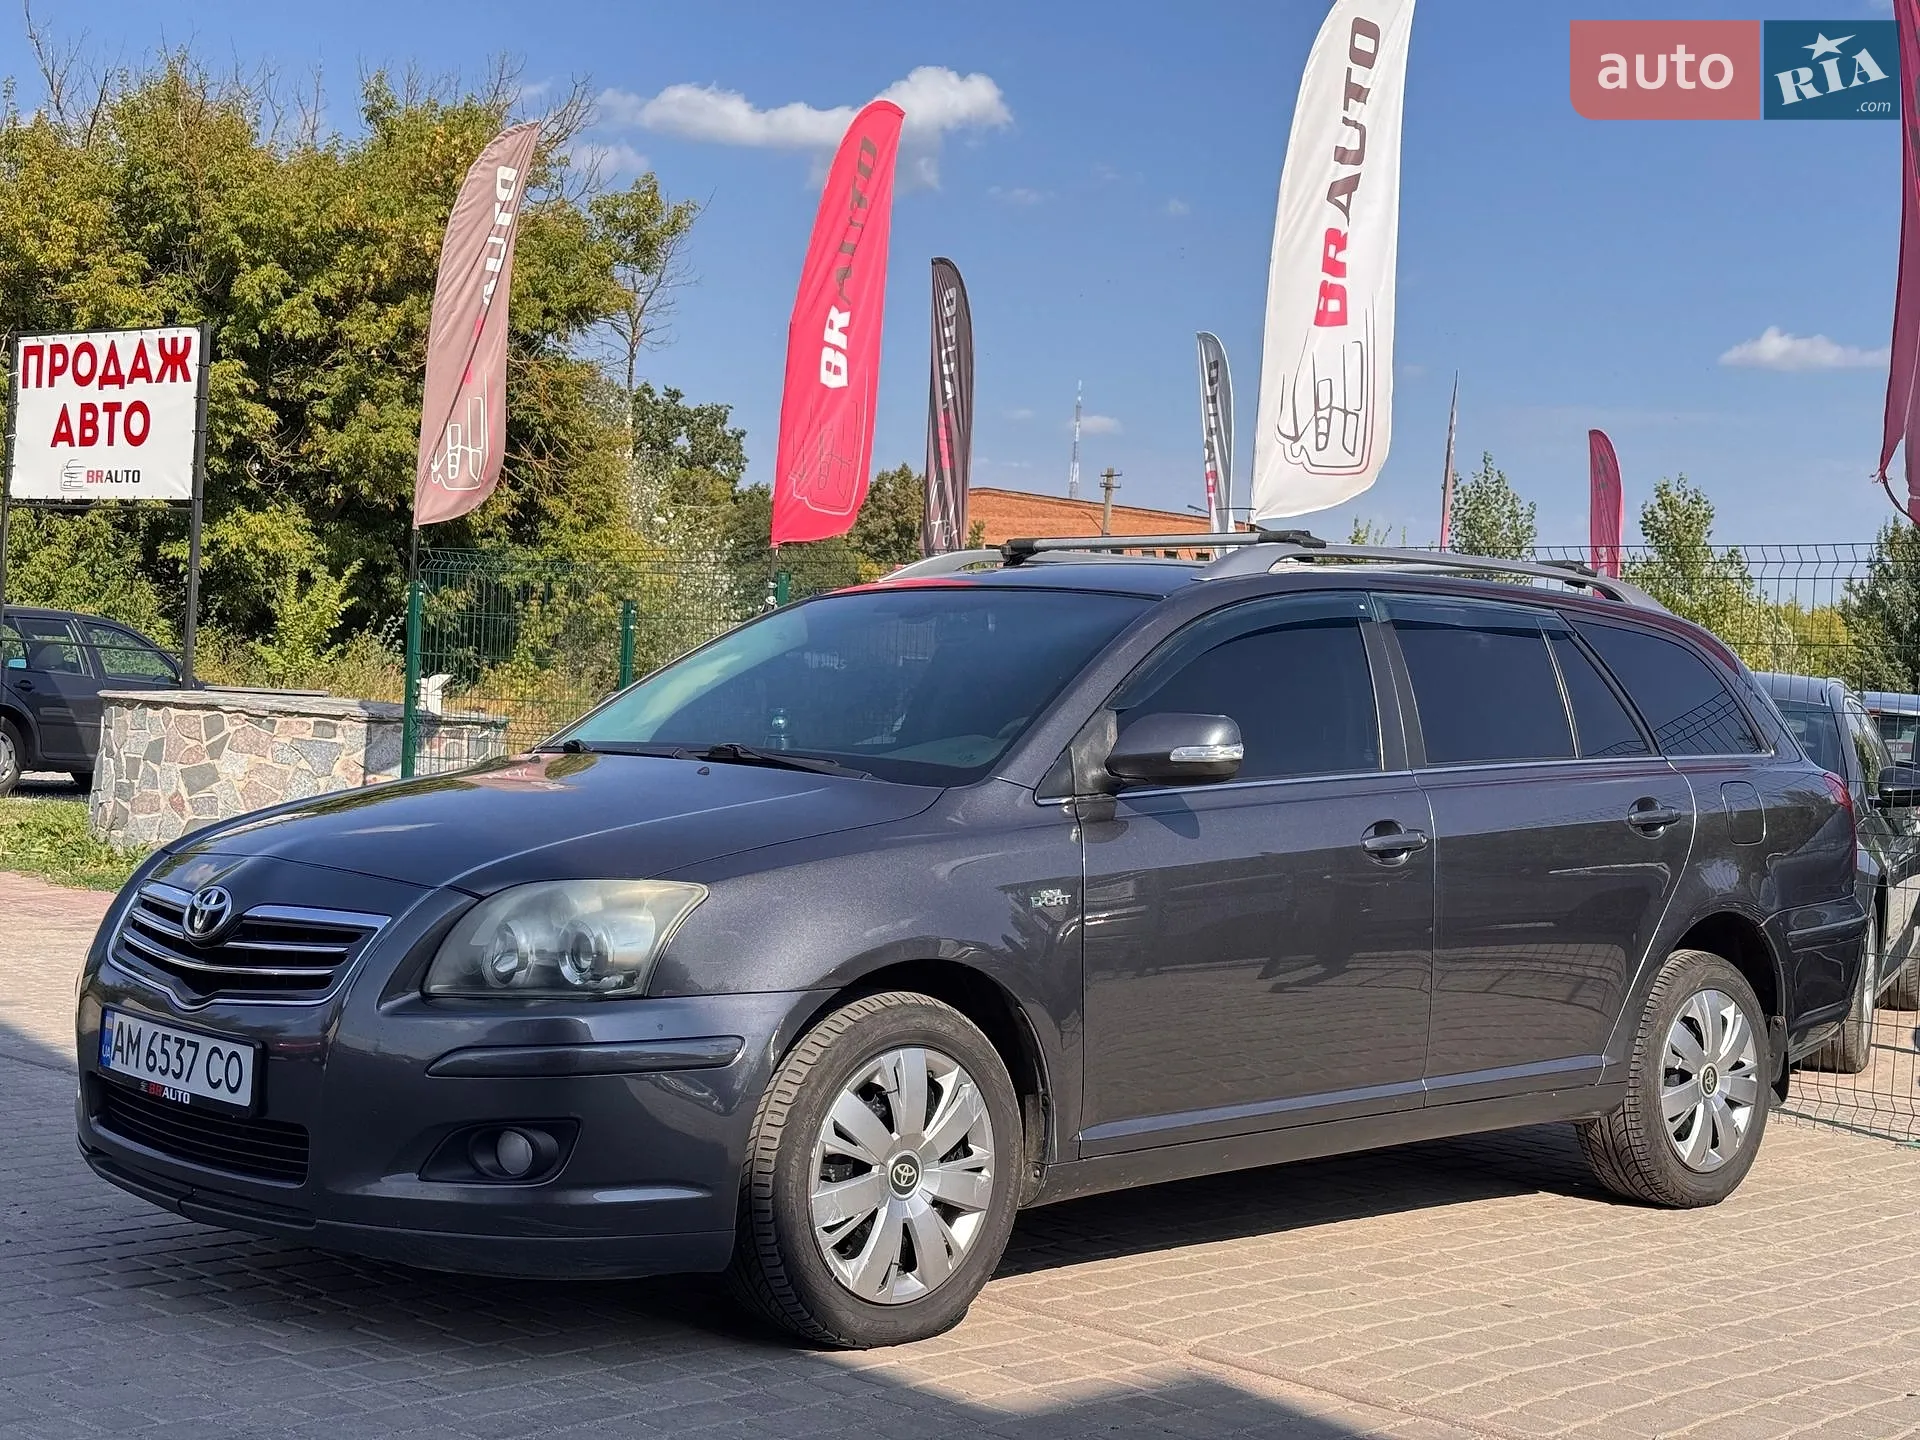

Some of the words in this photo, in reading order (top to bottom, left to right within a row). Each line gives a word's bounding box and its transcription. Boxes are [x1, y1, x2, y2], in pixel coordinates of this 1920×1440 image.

[1313, 16, 1381, 328] BRAUTO
[21, 336, 193, 391] ПРОДАЖ
[50, 400, 151, 448] АВТО
[85, 468, 142, 484] BRAUTO
[111, 1020, 143, 1070] AM
[145, 1031, 200, 1084] 6537
[205, 1045, 243, 1095] CO
[147, 1083, 191, 1104] BRAUTO
